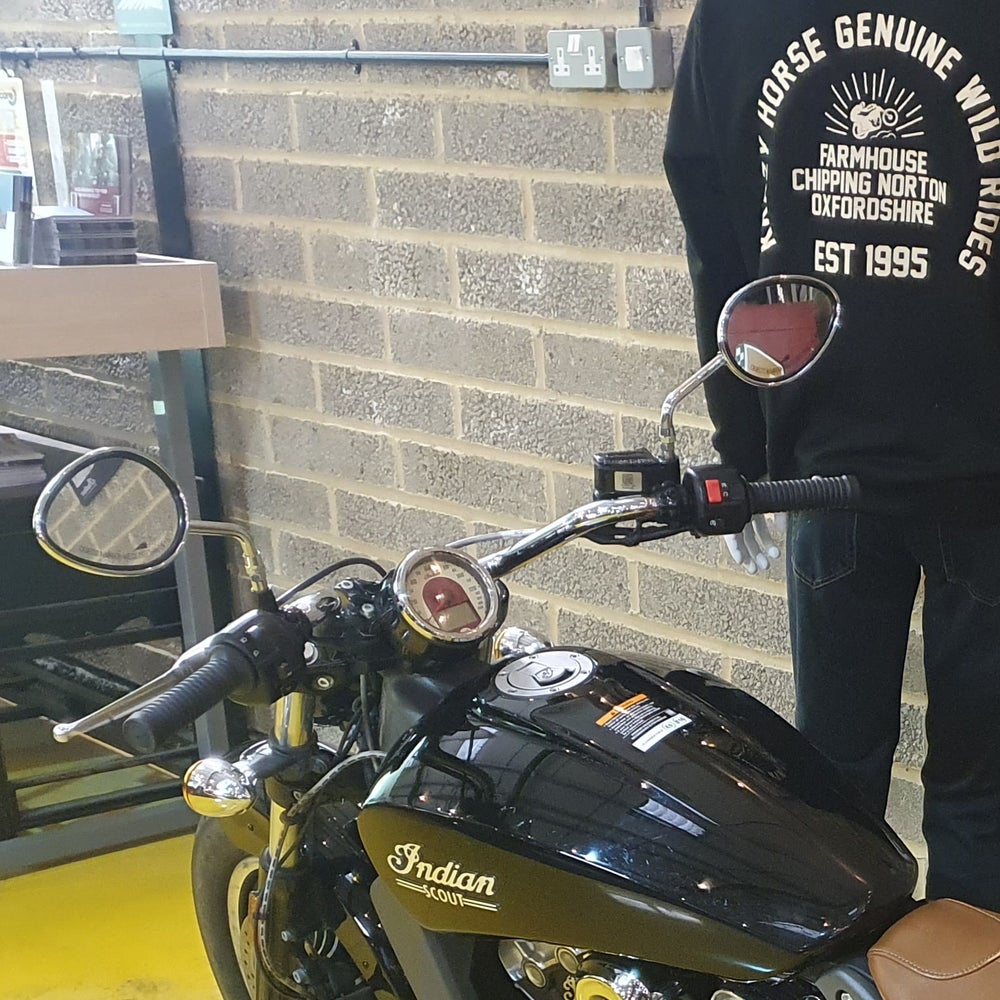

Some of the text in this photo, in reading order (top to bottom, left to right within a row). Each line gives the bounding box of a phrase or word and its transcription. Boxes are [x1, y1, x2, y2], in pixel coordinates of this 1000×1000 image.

[757, 26, 828, 129] HORSE
[834, 11, 963, 82] GENUINE
[819, 143, 928, 175] FARMHOUSE
[791, 168, 947, 206] CHIPPING NORTON
[811, 193, 935, 226] OXFORDSHIRE
[814, 239, 929, 279] EST 1995
[387, 843, 497, 896] Indian
[423, 884, 465, 907] SCOUT
